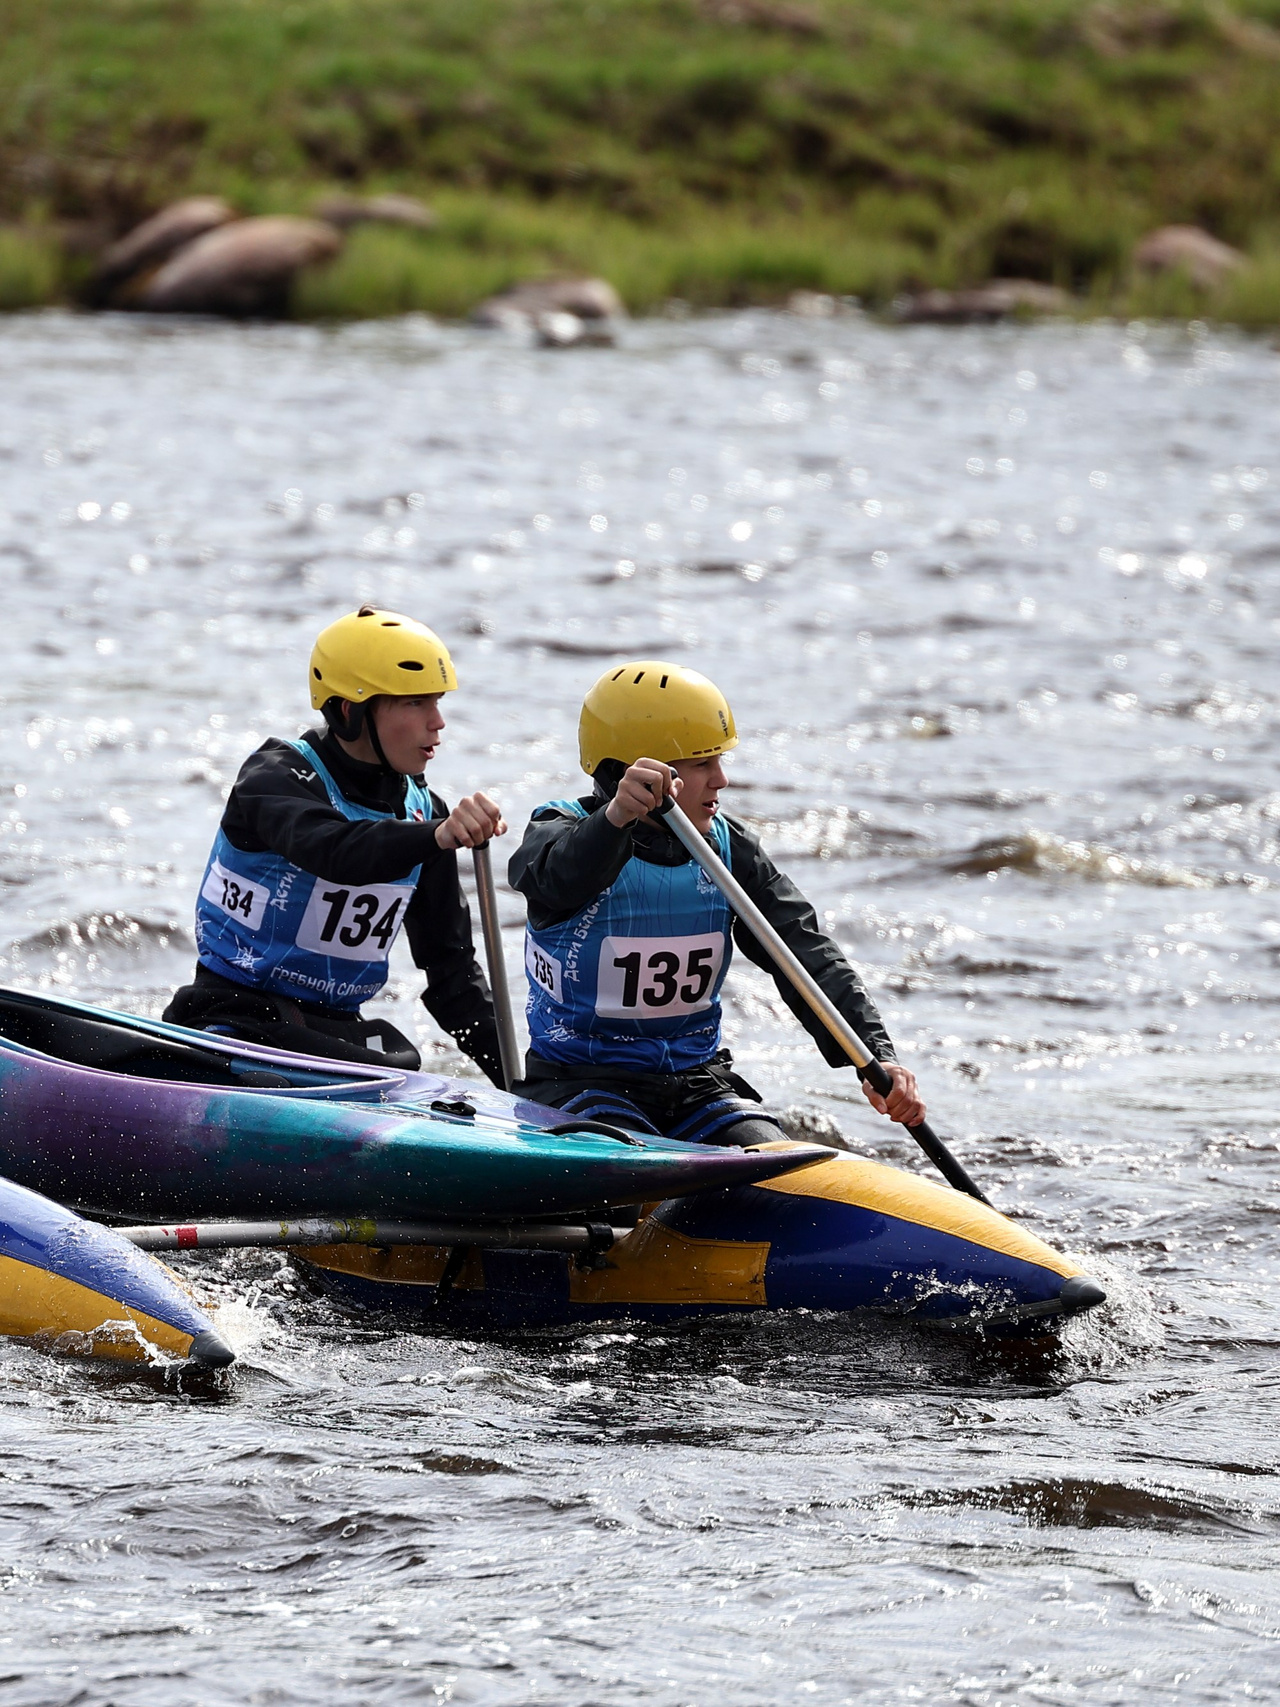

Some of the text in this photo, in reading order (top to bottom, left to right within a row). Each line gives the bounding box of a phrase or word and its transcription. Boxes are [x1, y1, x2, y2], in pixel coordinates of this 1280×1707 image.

[221, 878, 254, 919] 134
[320, 888, 403, 950] 134
[533, 950, 554, 991] 135
[613, 947, 713, 1007] 135
